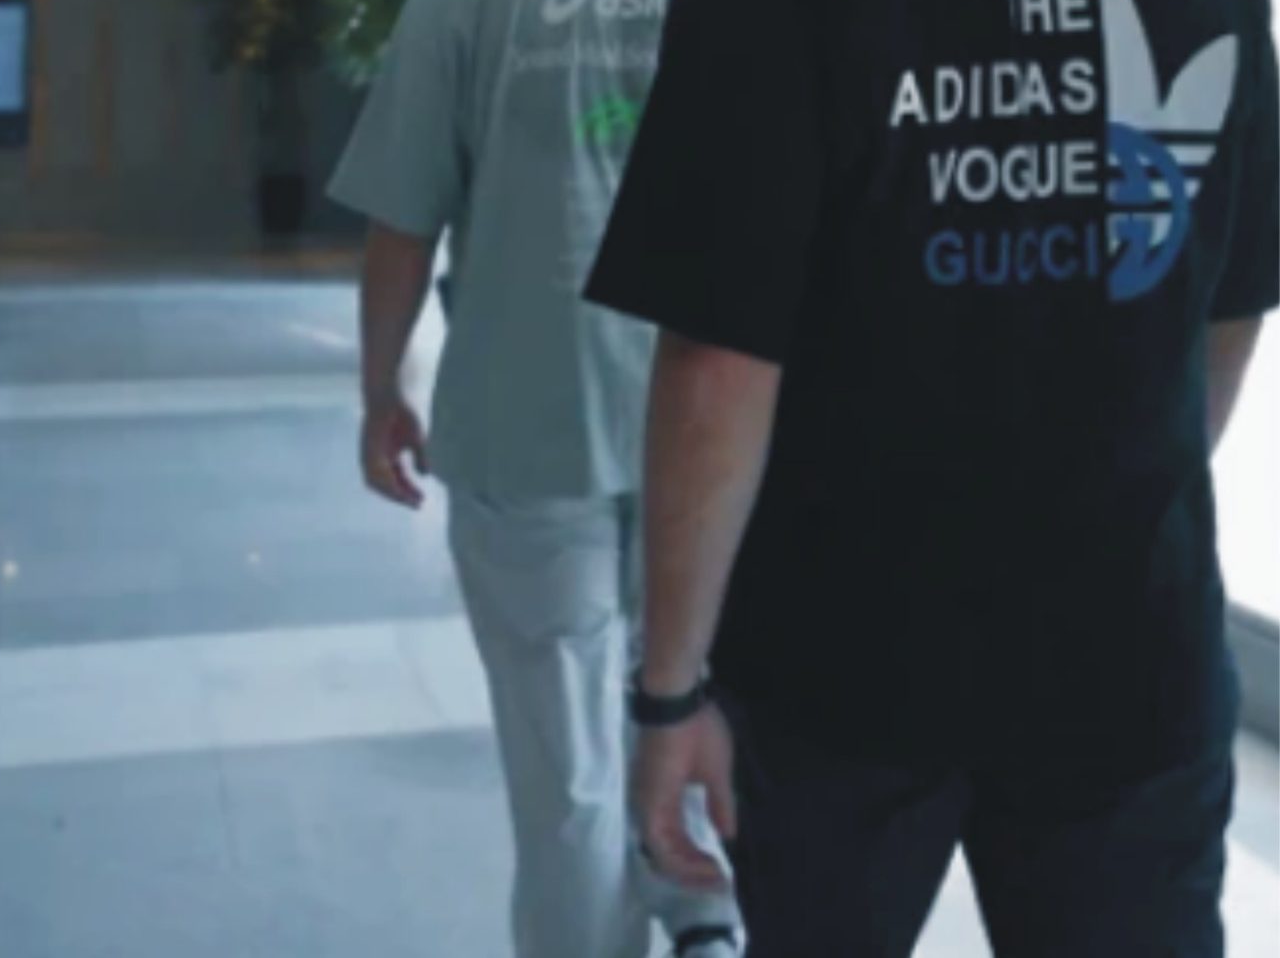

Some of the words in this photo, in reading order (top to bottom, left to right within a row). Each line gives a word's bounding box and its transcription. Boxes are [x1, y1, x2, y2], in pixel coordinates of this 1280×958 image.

[890, 58, 1097, 127] ADIDAS
[929, 141, 1098, 203] VOGUE
[925, 222, 1100, 286] GUCCI
